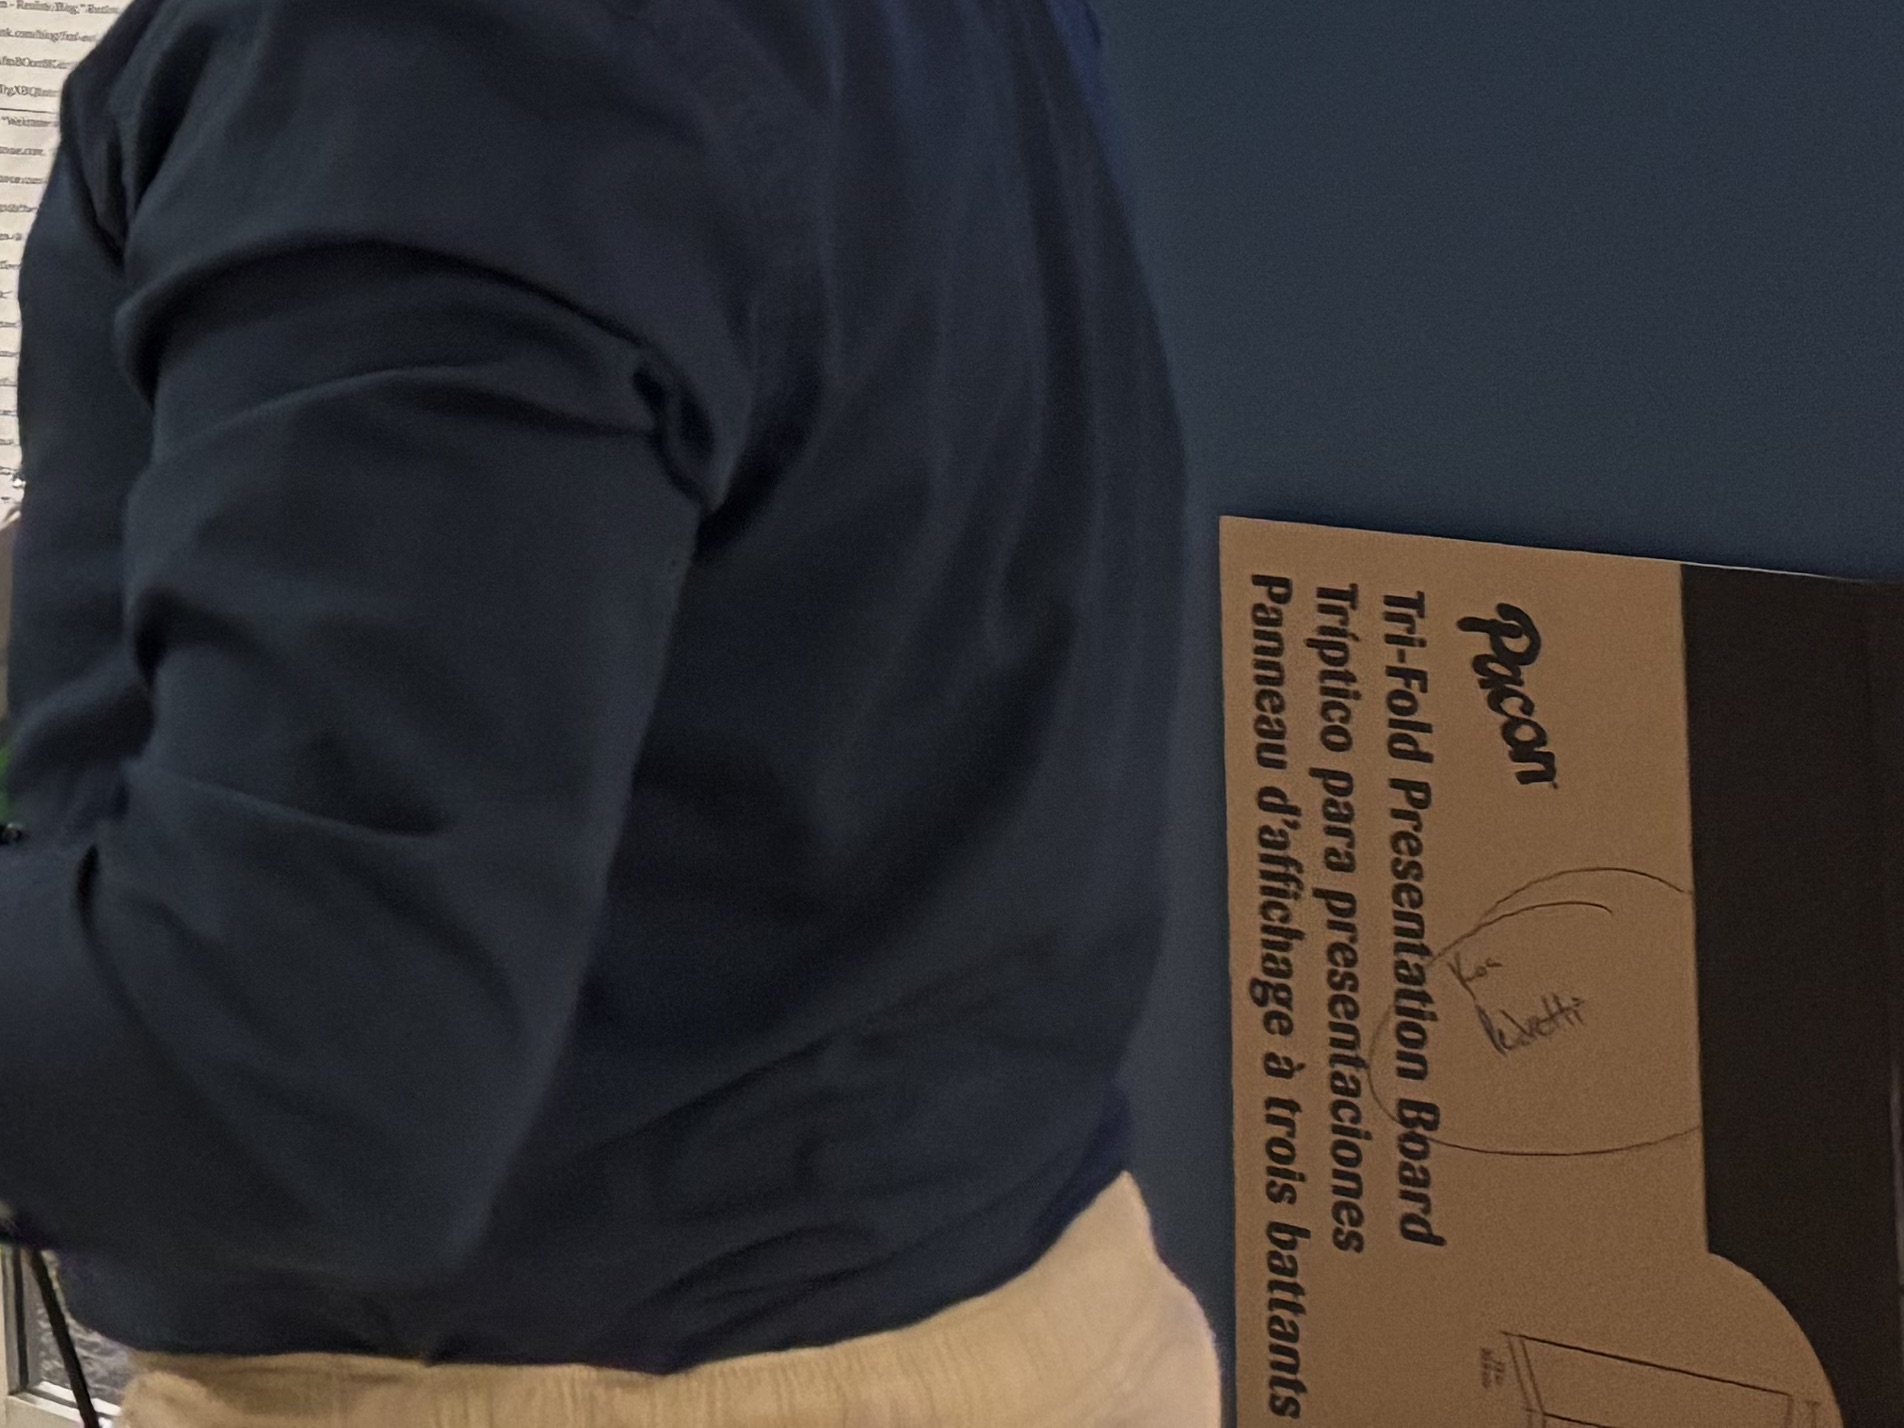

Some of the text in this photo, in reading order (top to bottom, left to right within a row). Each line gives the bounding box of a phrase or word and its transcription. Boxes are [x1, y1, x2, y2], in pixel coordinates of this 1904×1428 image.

[1309, 765, 1357, 871] para
[1457, 603, 1557, 788] Pacon
[1249, 573, 1311, 1419] Panneau d'affichage à trois battants
[1313, 887, 1367, 1253] presentaciones
[1382, 590, 1446, 1246] Tri-Fold Presentation Board
